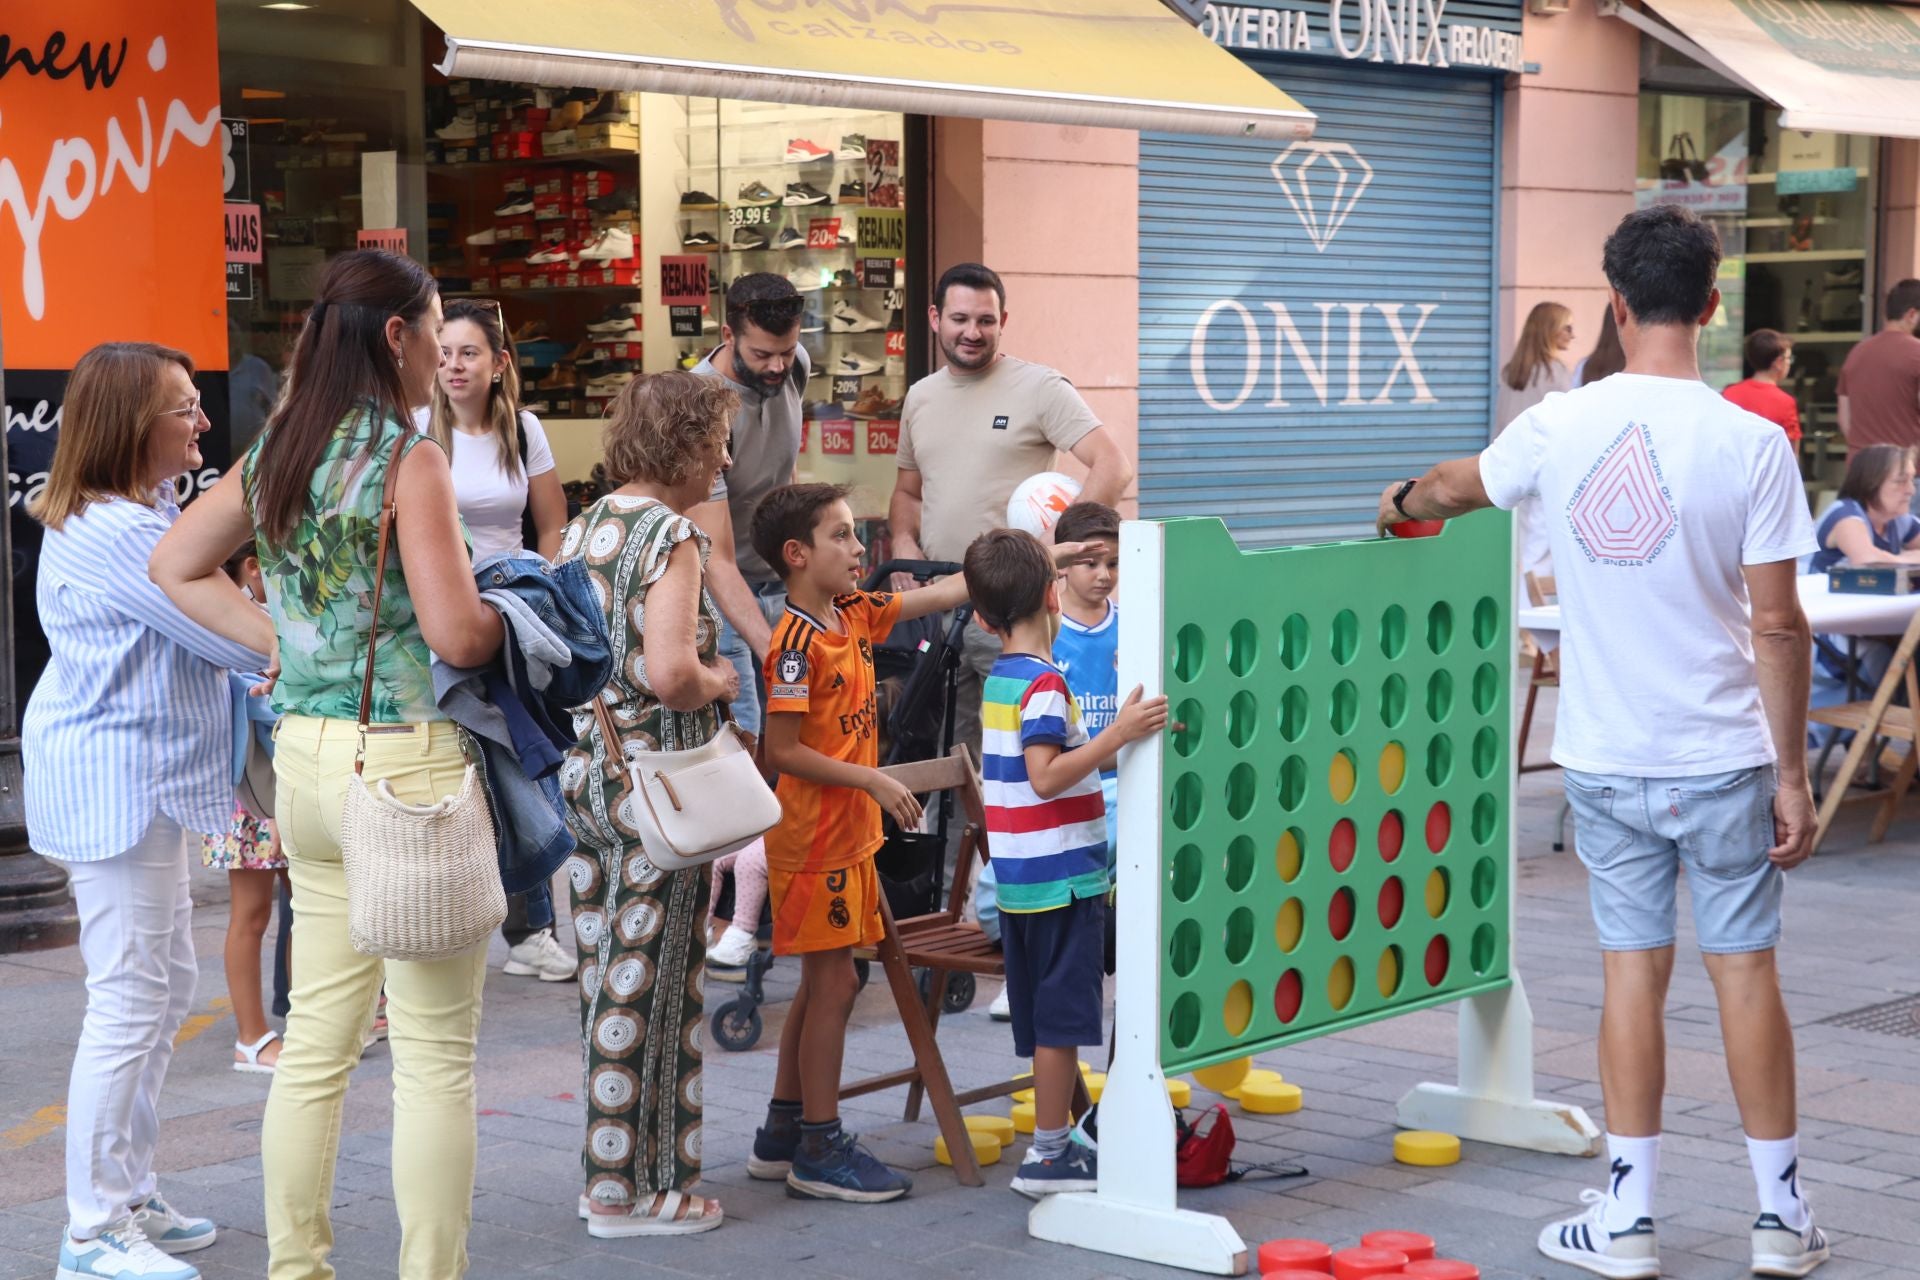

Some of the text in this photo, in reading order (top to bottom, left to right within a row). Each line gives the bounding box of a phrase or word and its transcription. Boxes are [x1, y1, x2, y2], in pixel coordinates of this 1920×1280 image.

[768, 18, 1022, 55] calzados
[1197, 3, 1311, 51] OYERIA
[1329, 0, 1449, 67] ONIX
[0, 31, 127, 91] new
[729, 206, 771, 225] 39.99 €
[225, 214, 259, 253] AJAS
[810, 229, 837, 246] 20%
[857, 216, 903, 250] REBAJAS
[661, 263, 707, 297] REBAJAS
[1190, 299, 1440, 411] ONIX
[833, 381, 858, 394] -20%
[824, 432, 851, 450] 30%
[870, 432, 897, 450] 20%
[1565, 454, 1606, 511] TOGETHER
[1604, 420, 1636, 455] THERE
[1641, 423, 1654, 446] ARE
[1649, 449, 1665, 483] MORE
[1661, 486, 1673, 502] OF
[1603, 558, 1643, 567] STONE
[785, 665, 796, 674] 15
